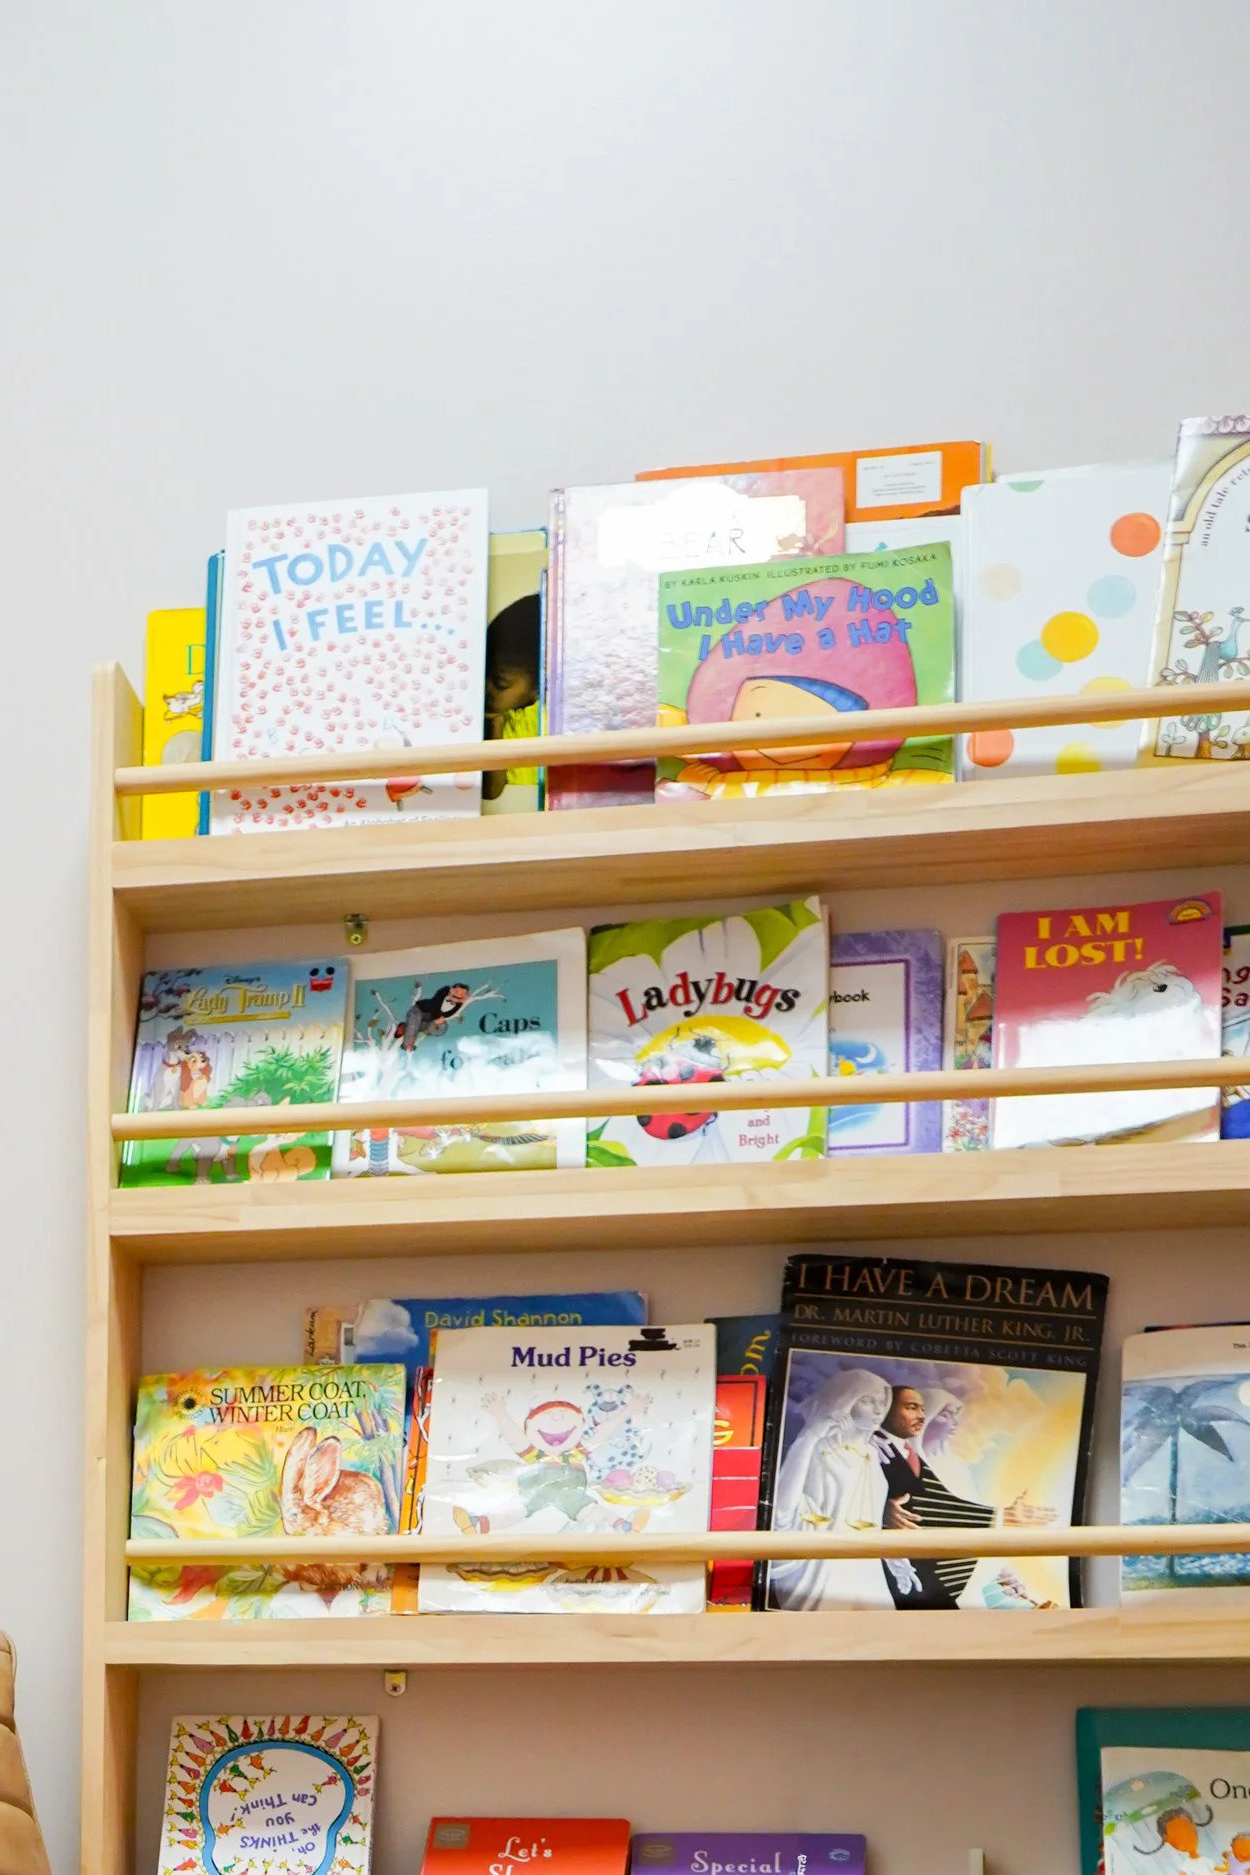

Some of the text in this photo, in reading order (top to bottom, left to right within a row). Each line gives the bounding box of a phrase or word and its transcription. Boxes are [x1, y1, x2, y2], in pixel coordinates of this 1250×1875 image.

[252, 538, 428, 595] TODAY
[664, 553, 938, 589] BY KARLA KUSKIN ILLUSTRATED BY FUMI KOSAKA
[666, 577, 940, 630] Under My Hood
[273, 600, 455, 651] I FEEL...
[698, 618, 913, 661] I Have a Hat
[1038, 910, 1131, 940] I AM
[1024, 937, 1144, 969] LOST!
[291, 983, 307, 1009] II
[615, 970, 801, 1027] Ladybugs
[478, 1011, 542, 1036] Caps
[747, 1115, 771, 1129] and
[738, 1133, 780, 1149] Bright
[799, 1263, 1094, 1312] I HAVE A DREAM
[424, 1308, 583, 1328] David Shannon
[793, 1303, 825, 1321] DR.
[833, 1307, 910, 1327] MARTIN
[919, 1313, 994, 1335] LUTHER
[1063, 1325, 1091, 1343] JR.
[511, 1346, 637, 1368] Mud Pies
[791, 1332, 1087, 1367] FOREWORD BY CORETTA SCOTT KING
[210, 1383, 304, 1405] SUMMER
[209, 1402, 293, 1425] WINTER
[297, 1400, 356, 1422] COAT
[230, 1793, 318, 1822] Can Think!
[265, 1811, 296, 1827] you
[300, 1822, 321, 1836] the
[498, 1836, 552, 1862] Let's
